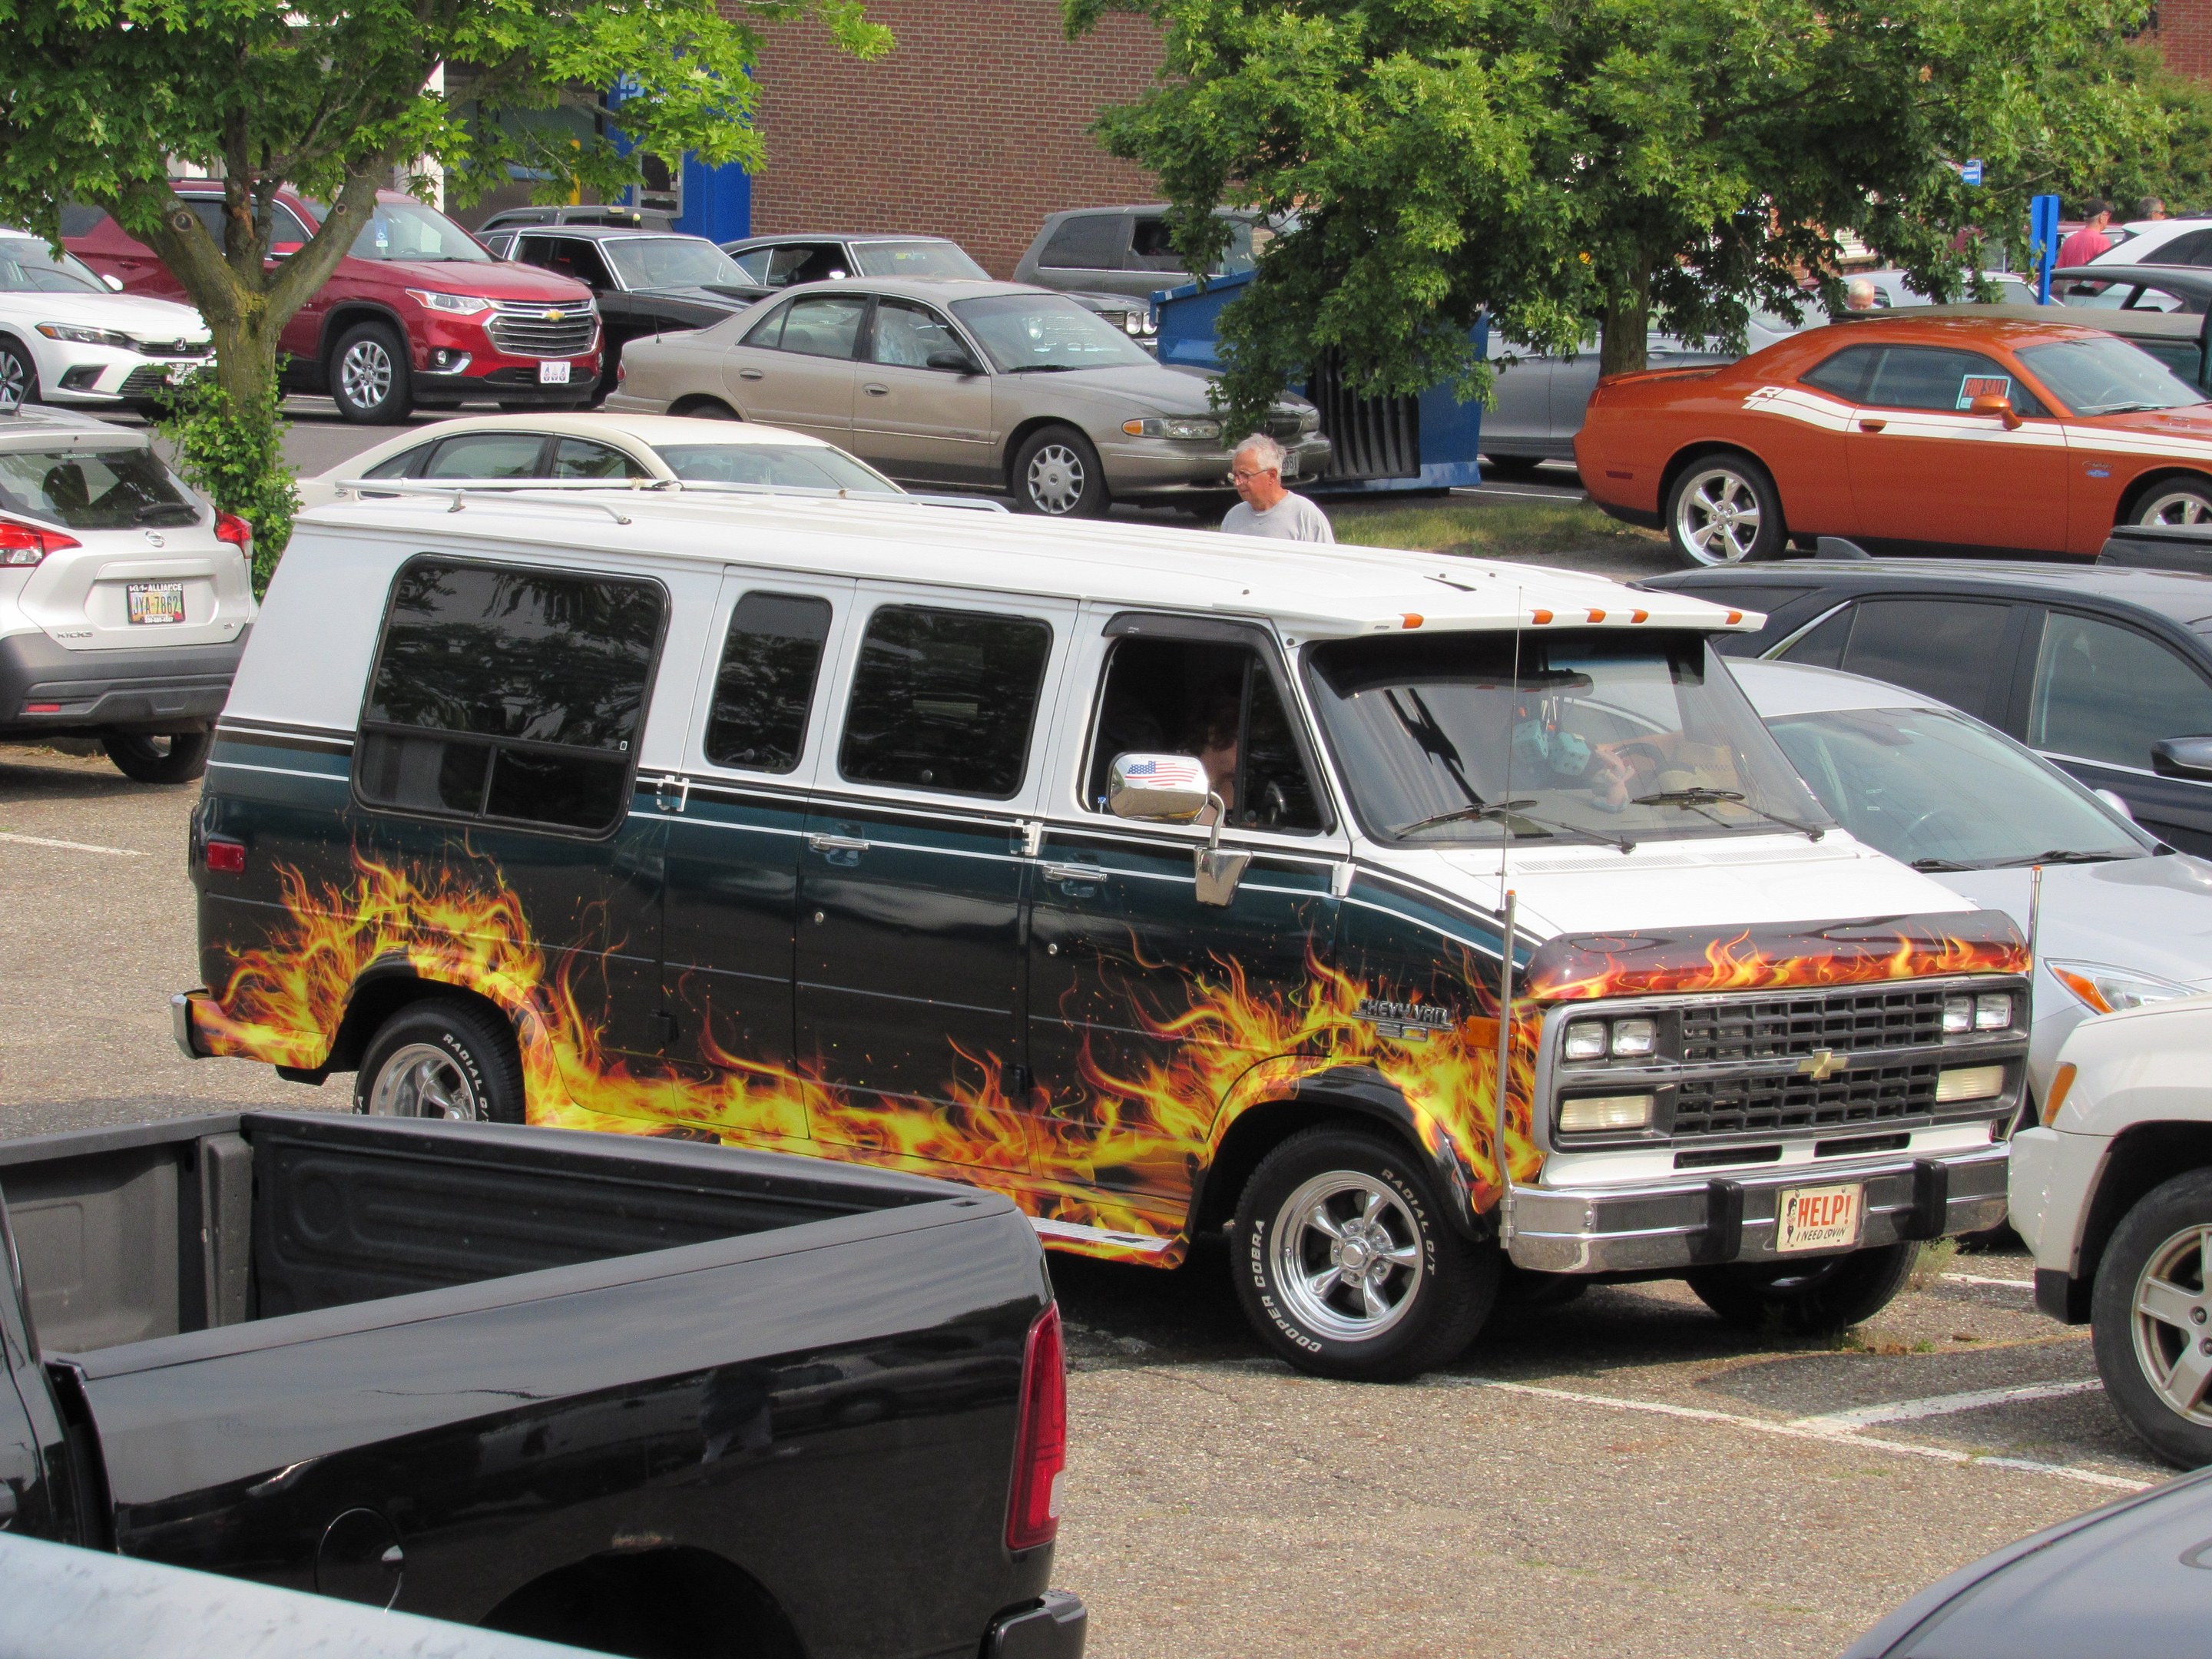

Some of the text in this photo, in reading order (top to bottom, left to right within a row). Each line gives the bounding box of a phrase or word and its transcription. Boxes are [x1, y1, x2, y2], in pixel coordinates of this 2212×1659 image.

[1962, 378, 2007, 397] FOR SALE
[133, 595, 178, 615] JYA 7862
[1359, 998, 1448, 1024] CHEVY VAN
[442, 1033, 482, 1091] RADIAL
[1381, 1168, 1435, 1276] RADIAL G/T
[1797, 1195, 1852, 1228] HELP!
[1796, 1231, 1800, 1242] I
[1801, 1230, 1823, 1241] NEED
[1251, 1220, 1323, 1353] COOPER COBRA
